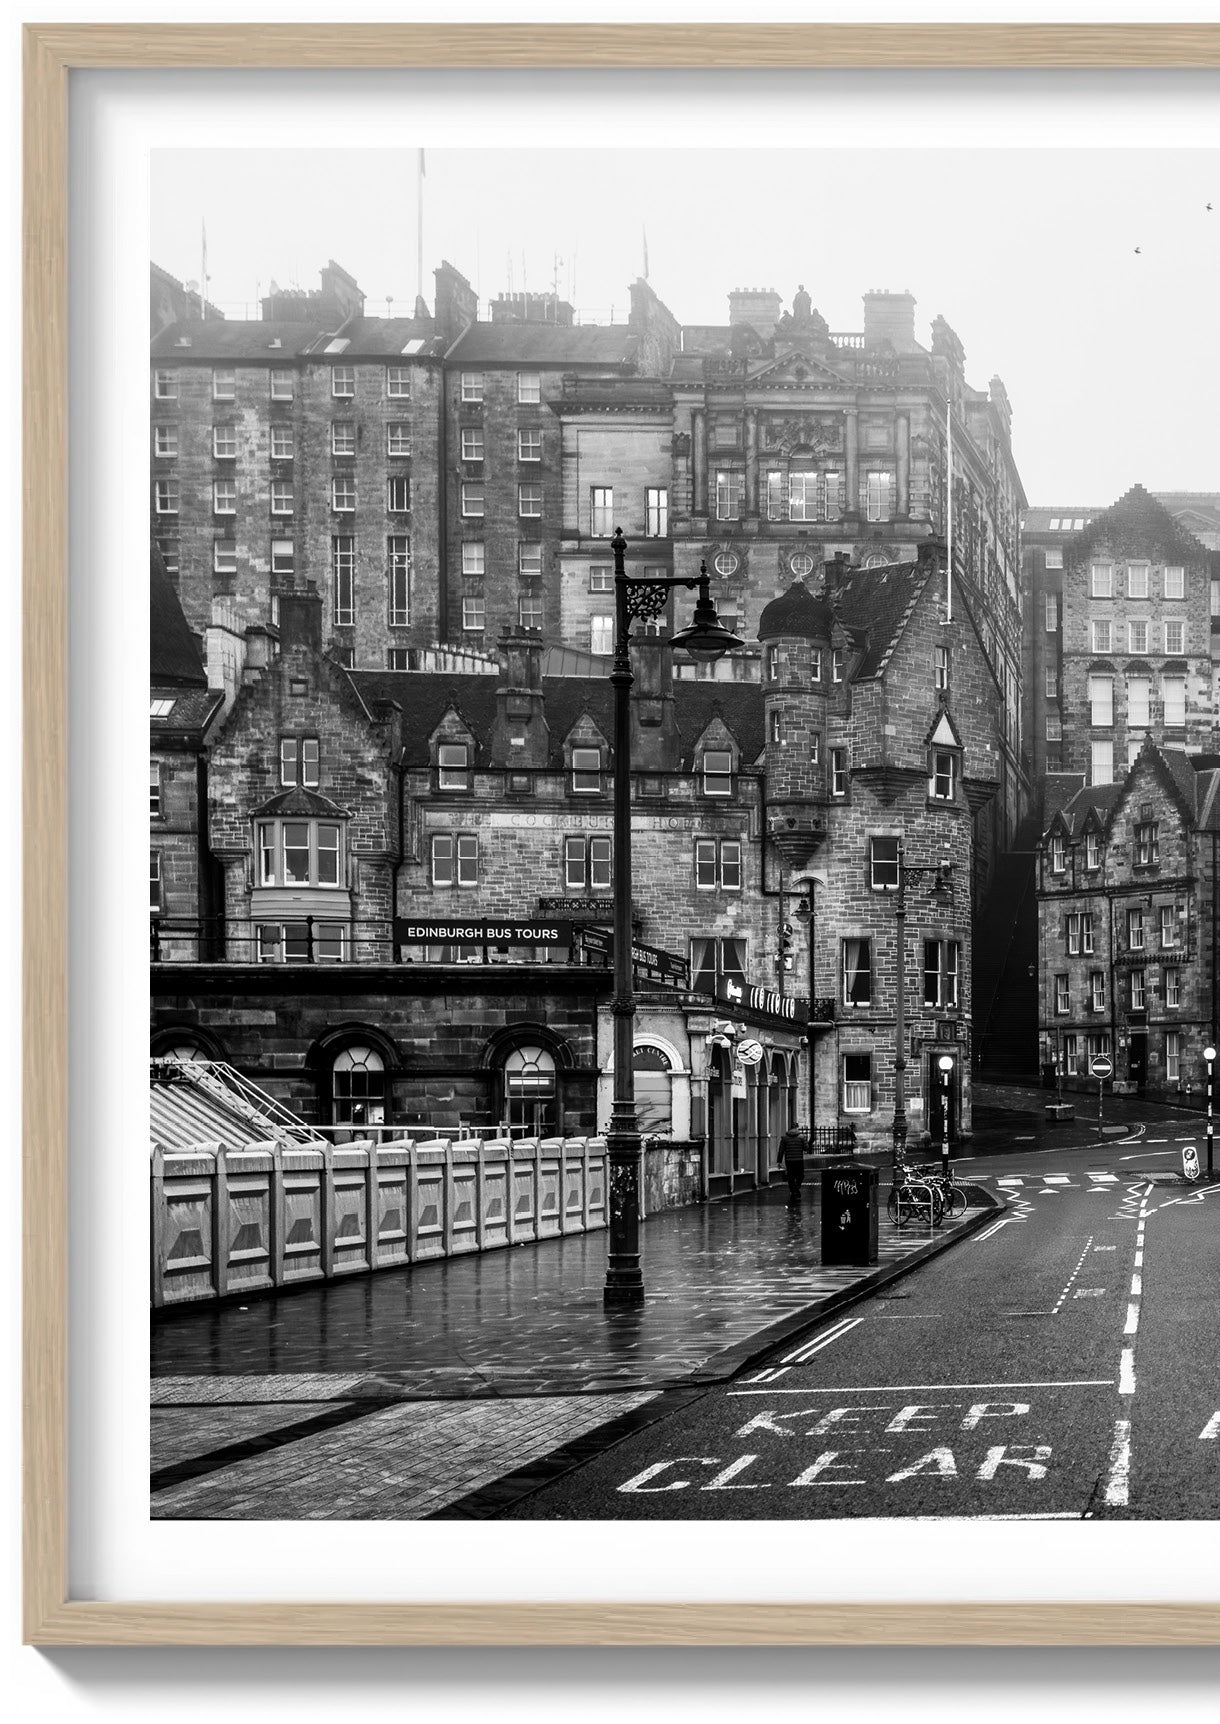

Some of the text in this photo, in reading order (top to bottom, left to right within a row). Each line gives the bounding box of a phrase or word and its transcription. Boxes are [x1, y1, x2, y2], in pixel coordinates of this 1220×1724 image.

[511, 814, 614, 828] COCKBUR
[407, 927, 559, 939] EDINBURGH BUS TOURS
[646, 952, 658, 967] TOURS
[647, 1047, 669, 1067] CENTRE
[731, 1403, 1030, 1438] KEEP
[616, 1445, 1052, 1493] CLEAR
